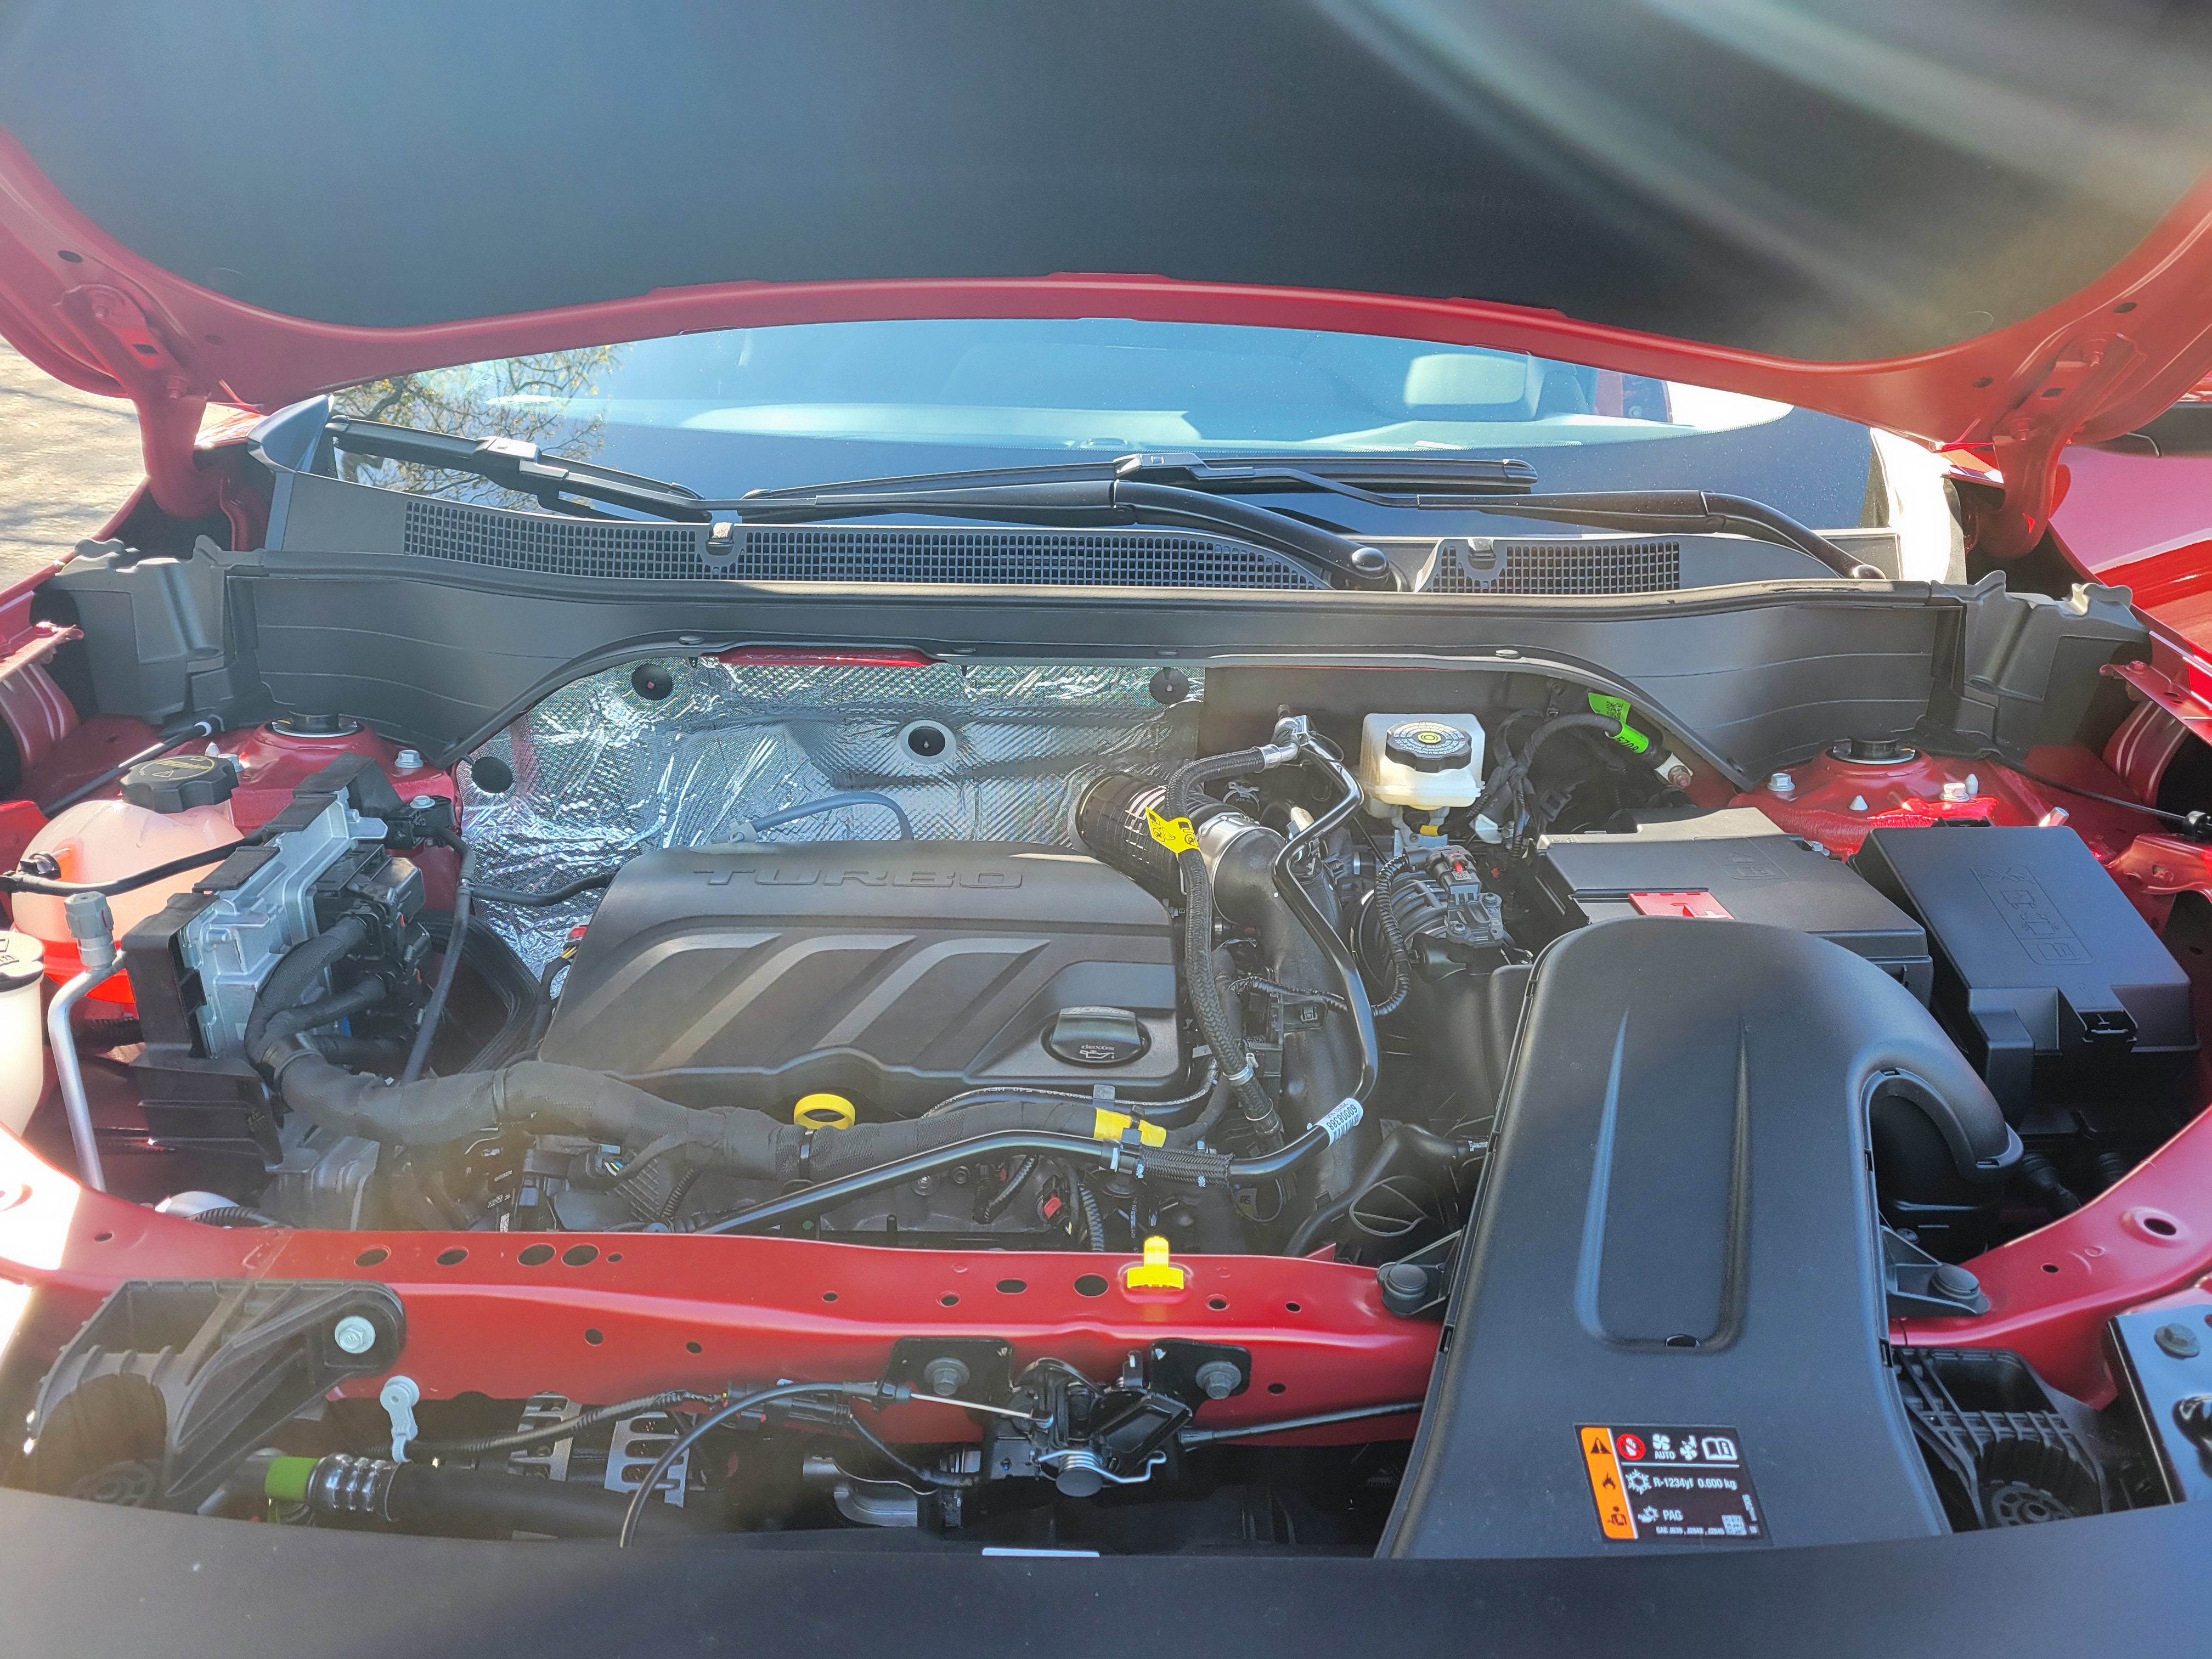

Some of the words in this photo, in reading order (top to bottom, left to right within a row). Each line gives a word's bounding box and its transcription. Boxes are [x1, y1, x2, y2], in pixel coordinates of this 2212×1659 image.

[693, 869, 1023, 889] TURBO
[1326, 1104, 1358, 1131] 60008388
[1654, 1451, 1676, 1460] AUTO
[1653, 1477, 1694, 1489] R-1234yf
[1697, 1477, 1722, 1489] 0.600
[1723, 1477, 1737, 1491] kg
[1662, 1510, 1683, 1521] PAG
